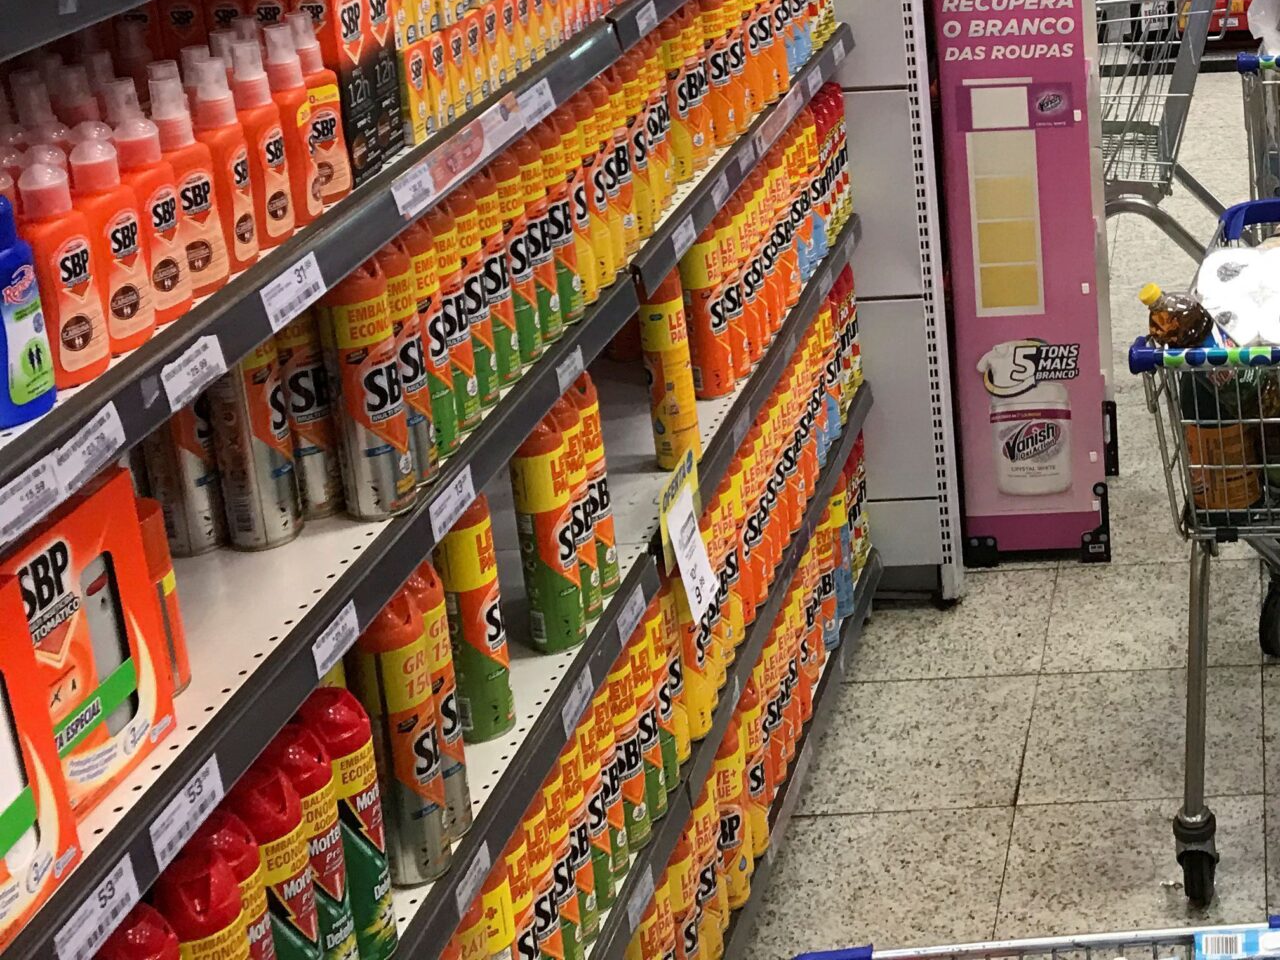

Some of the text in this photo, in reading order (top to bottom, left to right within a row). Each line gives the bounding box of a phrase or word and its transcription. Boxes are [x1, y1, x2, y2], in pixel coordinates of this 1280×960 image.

[256, 6, 280, 24] SBP
[341, 7, 362, 40] SBP
[943, 17, 1075, 38] O BRANCO
[945, 43, 1074, 61] DAS ROUPAS
[312, 117, 336, 140] SBP
[180, 180, 211, 211] SBP
[152, 197, 176, 229] SBP
[110, 221, 138, 254] SBP
[60, 249, 89, 282] SBP
[1010, 345, 1037, 382] 5
[1038, 358, 1076, 371] MAIS
[1041, 345, 1078, 358] TONS
[364, 360, 401, 412] SB
[1006, 422, 1056, 461] Vanish
[18, 541, 68, 622] SBP
[66, 697, 101, 742] ESPECIAL
